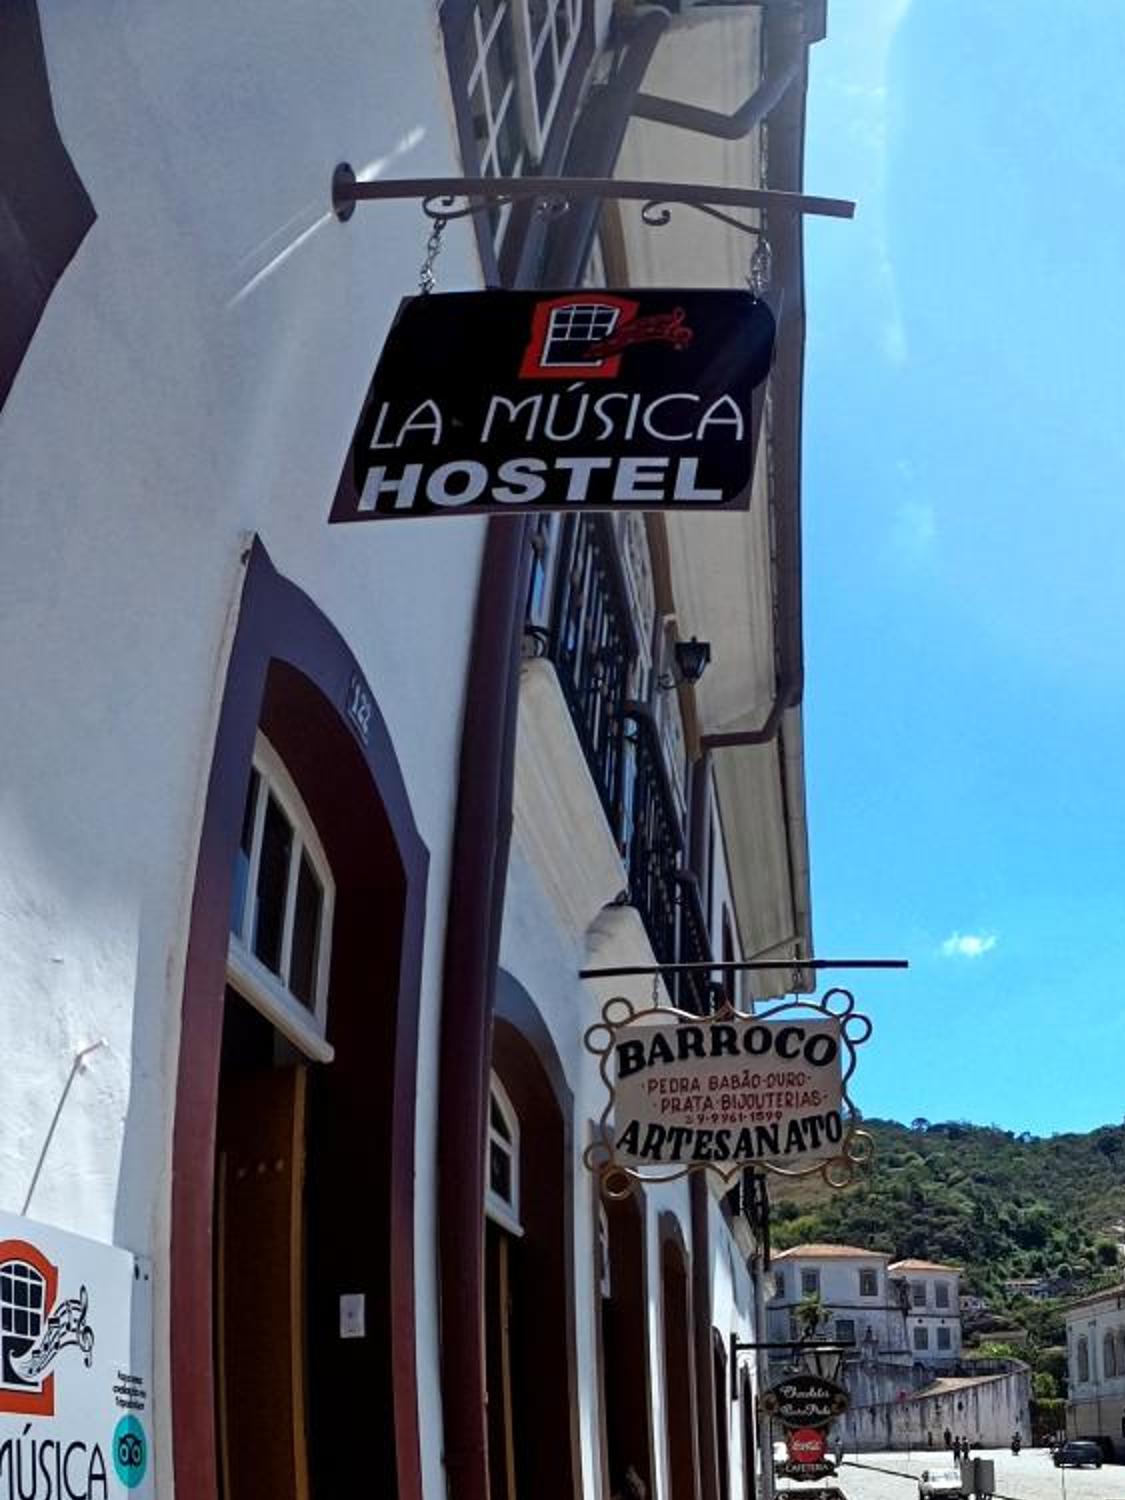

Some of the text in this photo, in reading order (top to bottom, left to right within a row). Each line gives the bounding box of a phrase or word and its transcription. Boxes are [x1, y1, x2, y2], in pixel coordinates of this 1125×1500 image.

[370, 381, 744, 449] LA MÚSICA
[358, 456, 723, 511] HOSTEL
[615, 1025, 838, 1079] BARROCO
[615, 1110, 843, 1161] ARTESANATO
